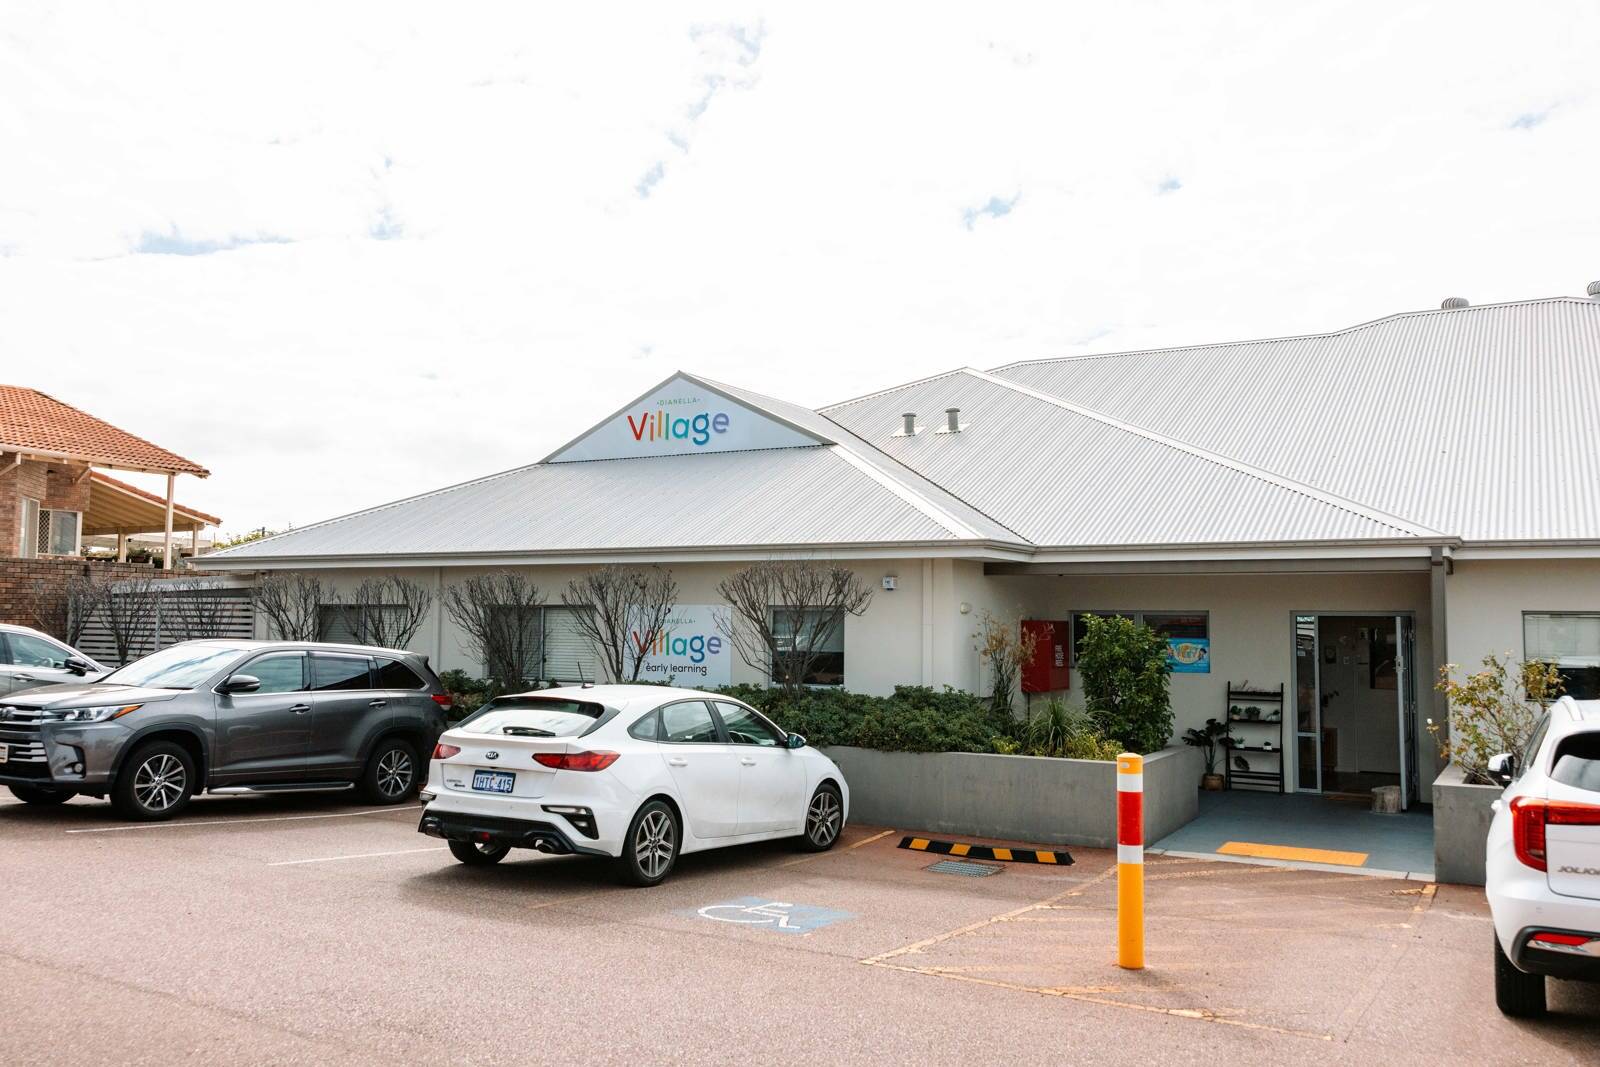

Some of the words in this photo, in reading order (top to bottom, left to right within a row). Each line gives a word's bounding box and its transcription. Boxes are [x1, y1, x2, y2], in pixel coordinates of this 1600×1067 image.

[659, 396, 697, 406] DIANELLA
[627, 410, 730, 446] Village
[633, 629, 722, 663] Village
[645, 663, 668, 674] early
[670, 664, 707, 676] learning
[497, 777, 513, 791] 415
